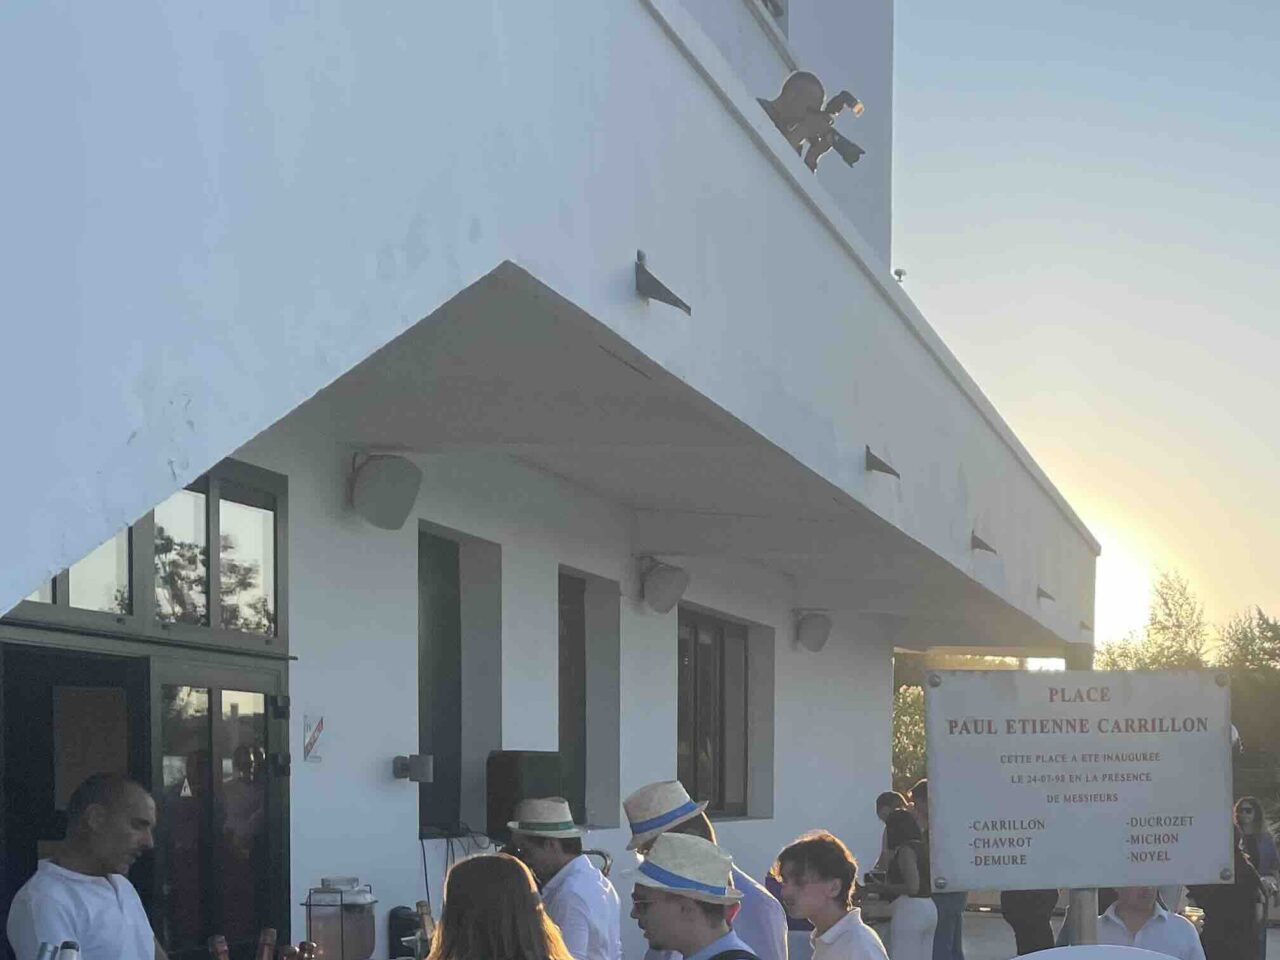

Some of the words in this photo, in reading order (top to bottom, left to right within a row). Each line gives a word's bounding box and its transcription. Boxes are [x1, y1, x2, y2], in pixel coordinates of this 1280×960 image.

[1048, 686, 1111, 703] PLACE
[948, 719, 998, 736] PAUL
[1005, 718, 1090, 735] ETIENNE
[1097, 717, 1209, 734] CARRILLON
[1000, 754, 1032, 764] CETTE
[1035, 753, 1067, 763] PLACE
[1103, 752, 1161, 762] INAUGUREE
[1011, 774, 1024, 784] LE
[1069, 773, 1083, 783] EN
[1086, 773, 1099, 783] LA
[1102, 772, 1152, 782] PRESENCE
[1046, 793, 1060, 803] DE
[1063, 793, 1119, 803] MESSIEURS
